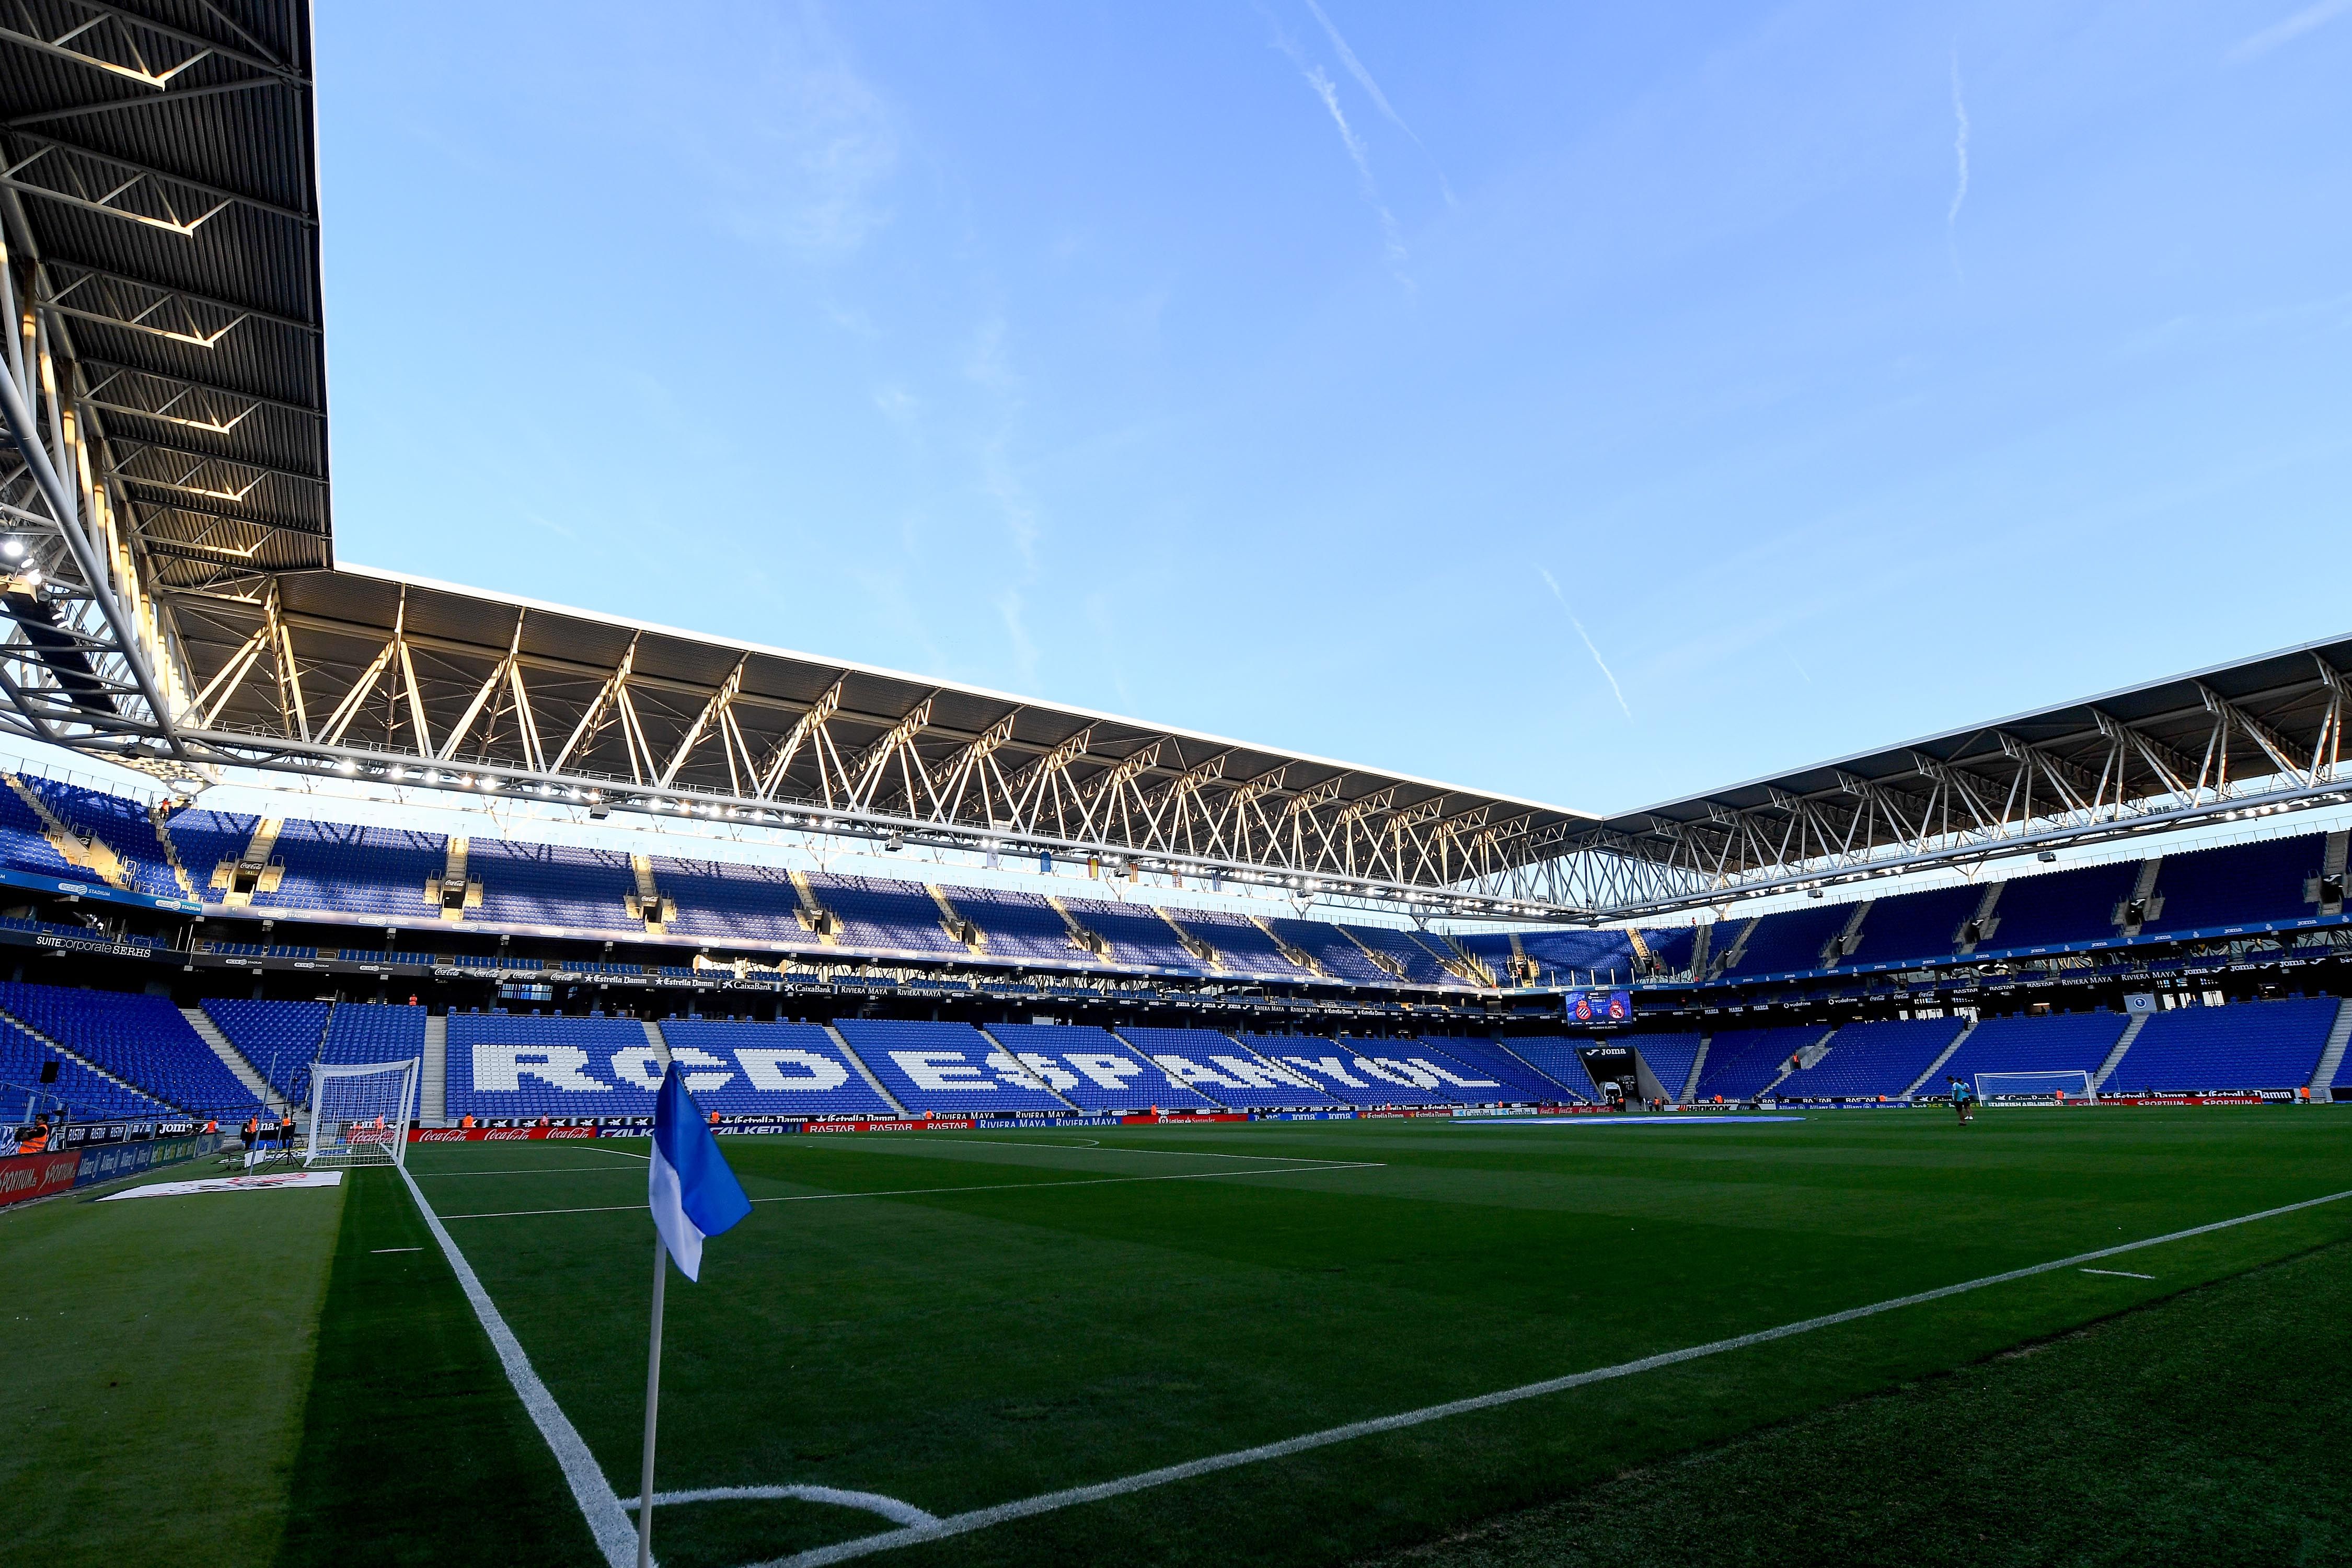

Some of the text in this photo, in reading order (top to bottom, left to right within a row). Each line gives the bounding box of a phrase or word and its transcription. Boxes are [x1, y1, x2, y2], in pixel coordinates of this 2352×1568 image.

[112, 946, 151, 959] SERHS
[435, 968, 461, 976] Coca-Cola
[594, 975, 622, 983] Estrella
[664, 978, 714, 987] Estrella Damm
[2061, 977, 2088, 986] RIVIERA
[734, 982, 771, 990] CaixaBank
[795, 984, 831, 993] CaixaBank
[472, 1044, 1501, 1092] RCD ESPANYOL
[980, 1119, 1046, 1128] RIVIERA MAYA
[1056, 1118, 1089, 1127] RIVIERA
[67, 1128, 85, 1141] RASTAR
[419, 1129, 470, 1142] Coca-Cola
[484, 1127, 532, 1140] Coca-Cola
[546, 1127, 592, 1140] Coca-Cola
[601, 1128, 655, 1137] FALK
